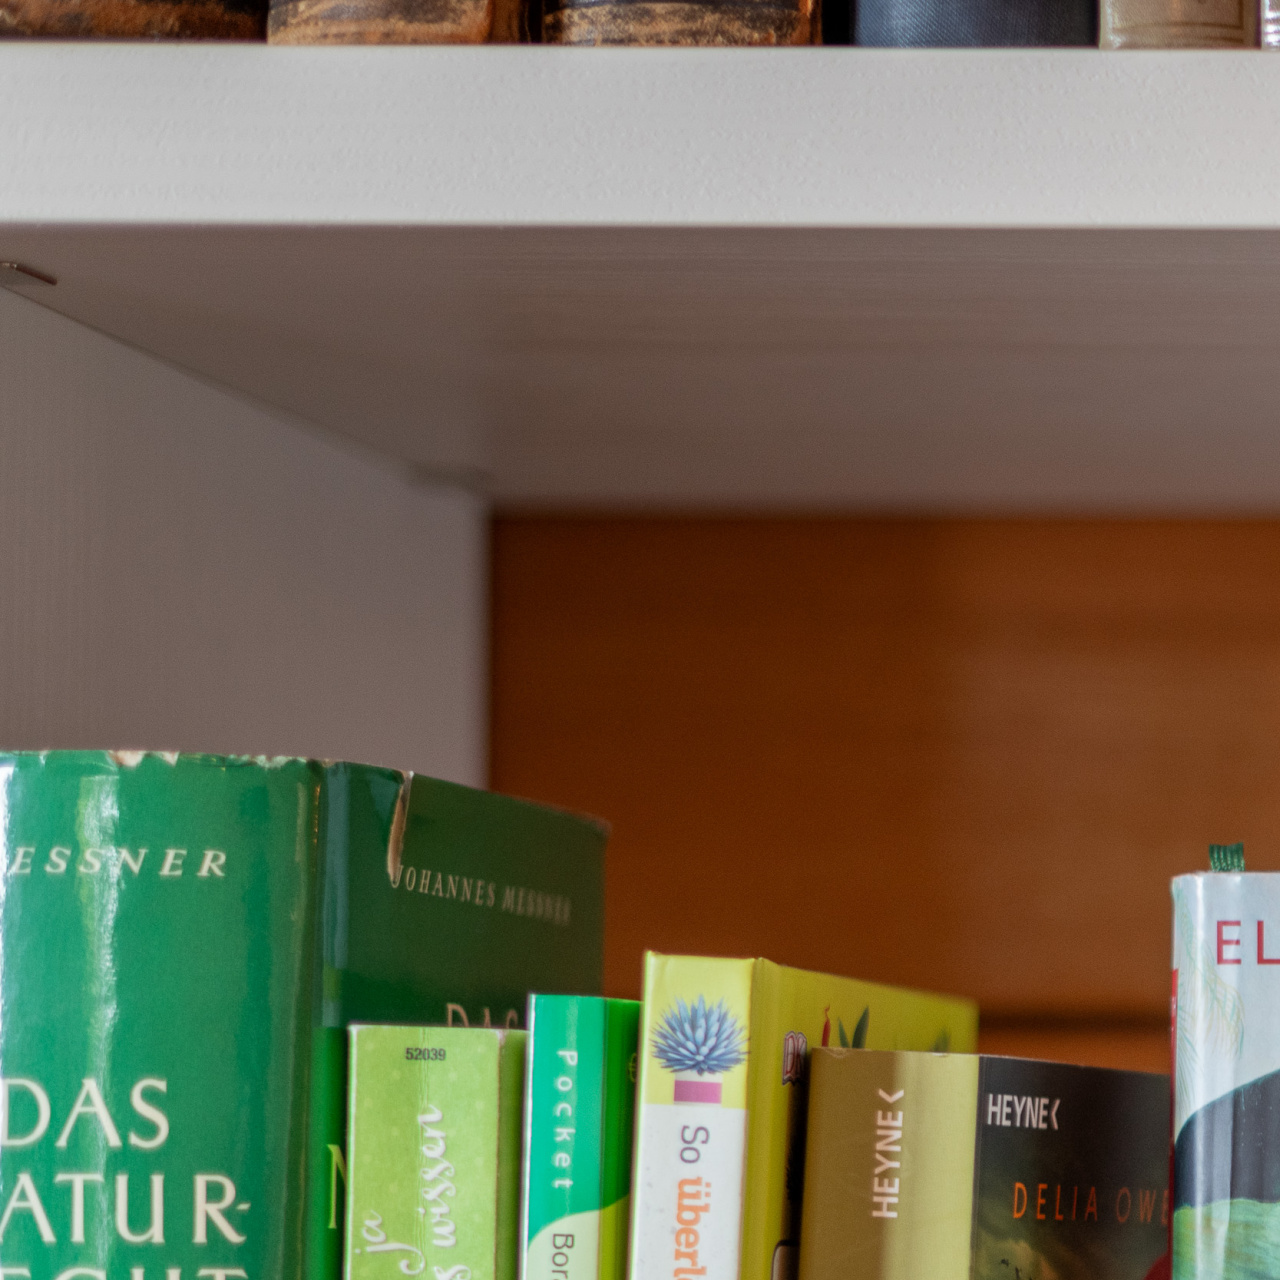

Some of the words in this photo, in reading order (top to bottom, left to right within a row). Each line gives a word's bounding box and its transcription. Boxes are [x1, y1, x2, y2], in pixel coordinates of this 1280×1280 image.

[391, 865, 496, 907] JOHANNES
[405, 1047, 446, 1062] 52039
[0, 1077, 170, 1148] DAS
[554, 1049, 579, 1190] Pocket
[680, 1125, 711, 1165] So
[417, 1104, 456, 1248] wissen
[1012, 1182, 1098, 1222] DELIA
[355, 1209, 425, 1276] ja
